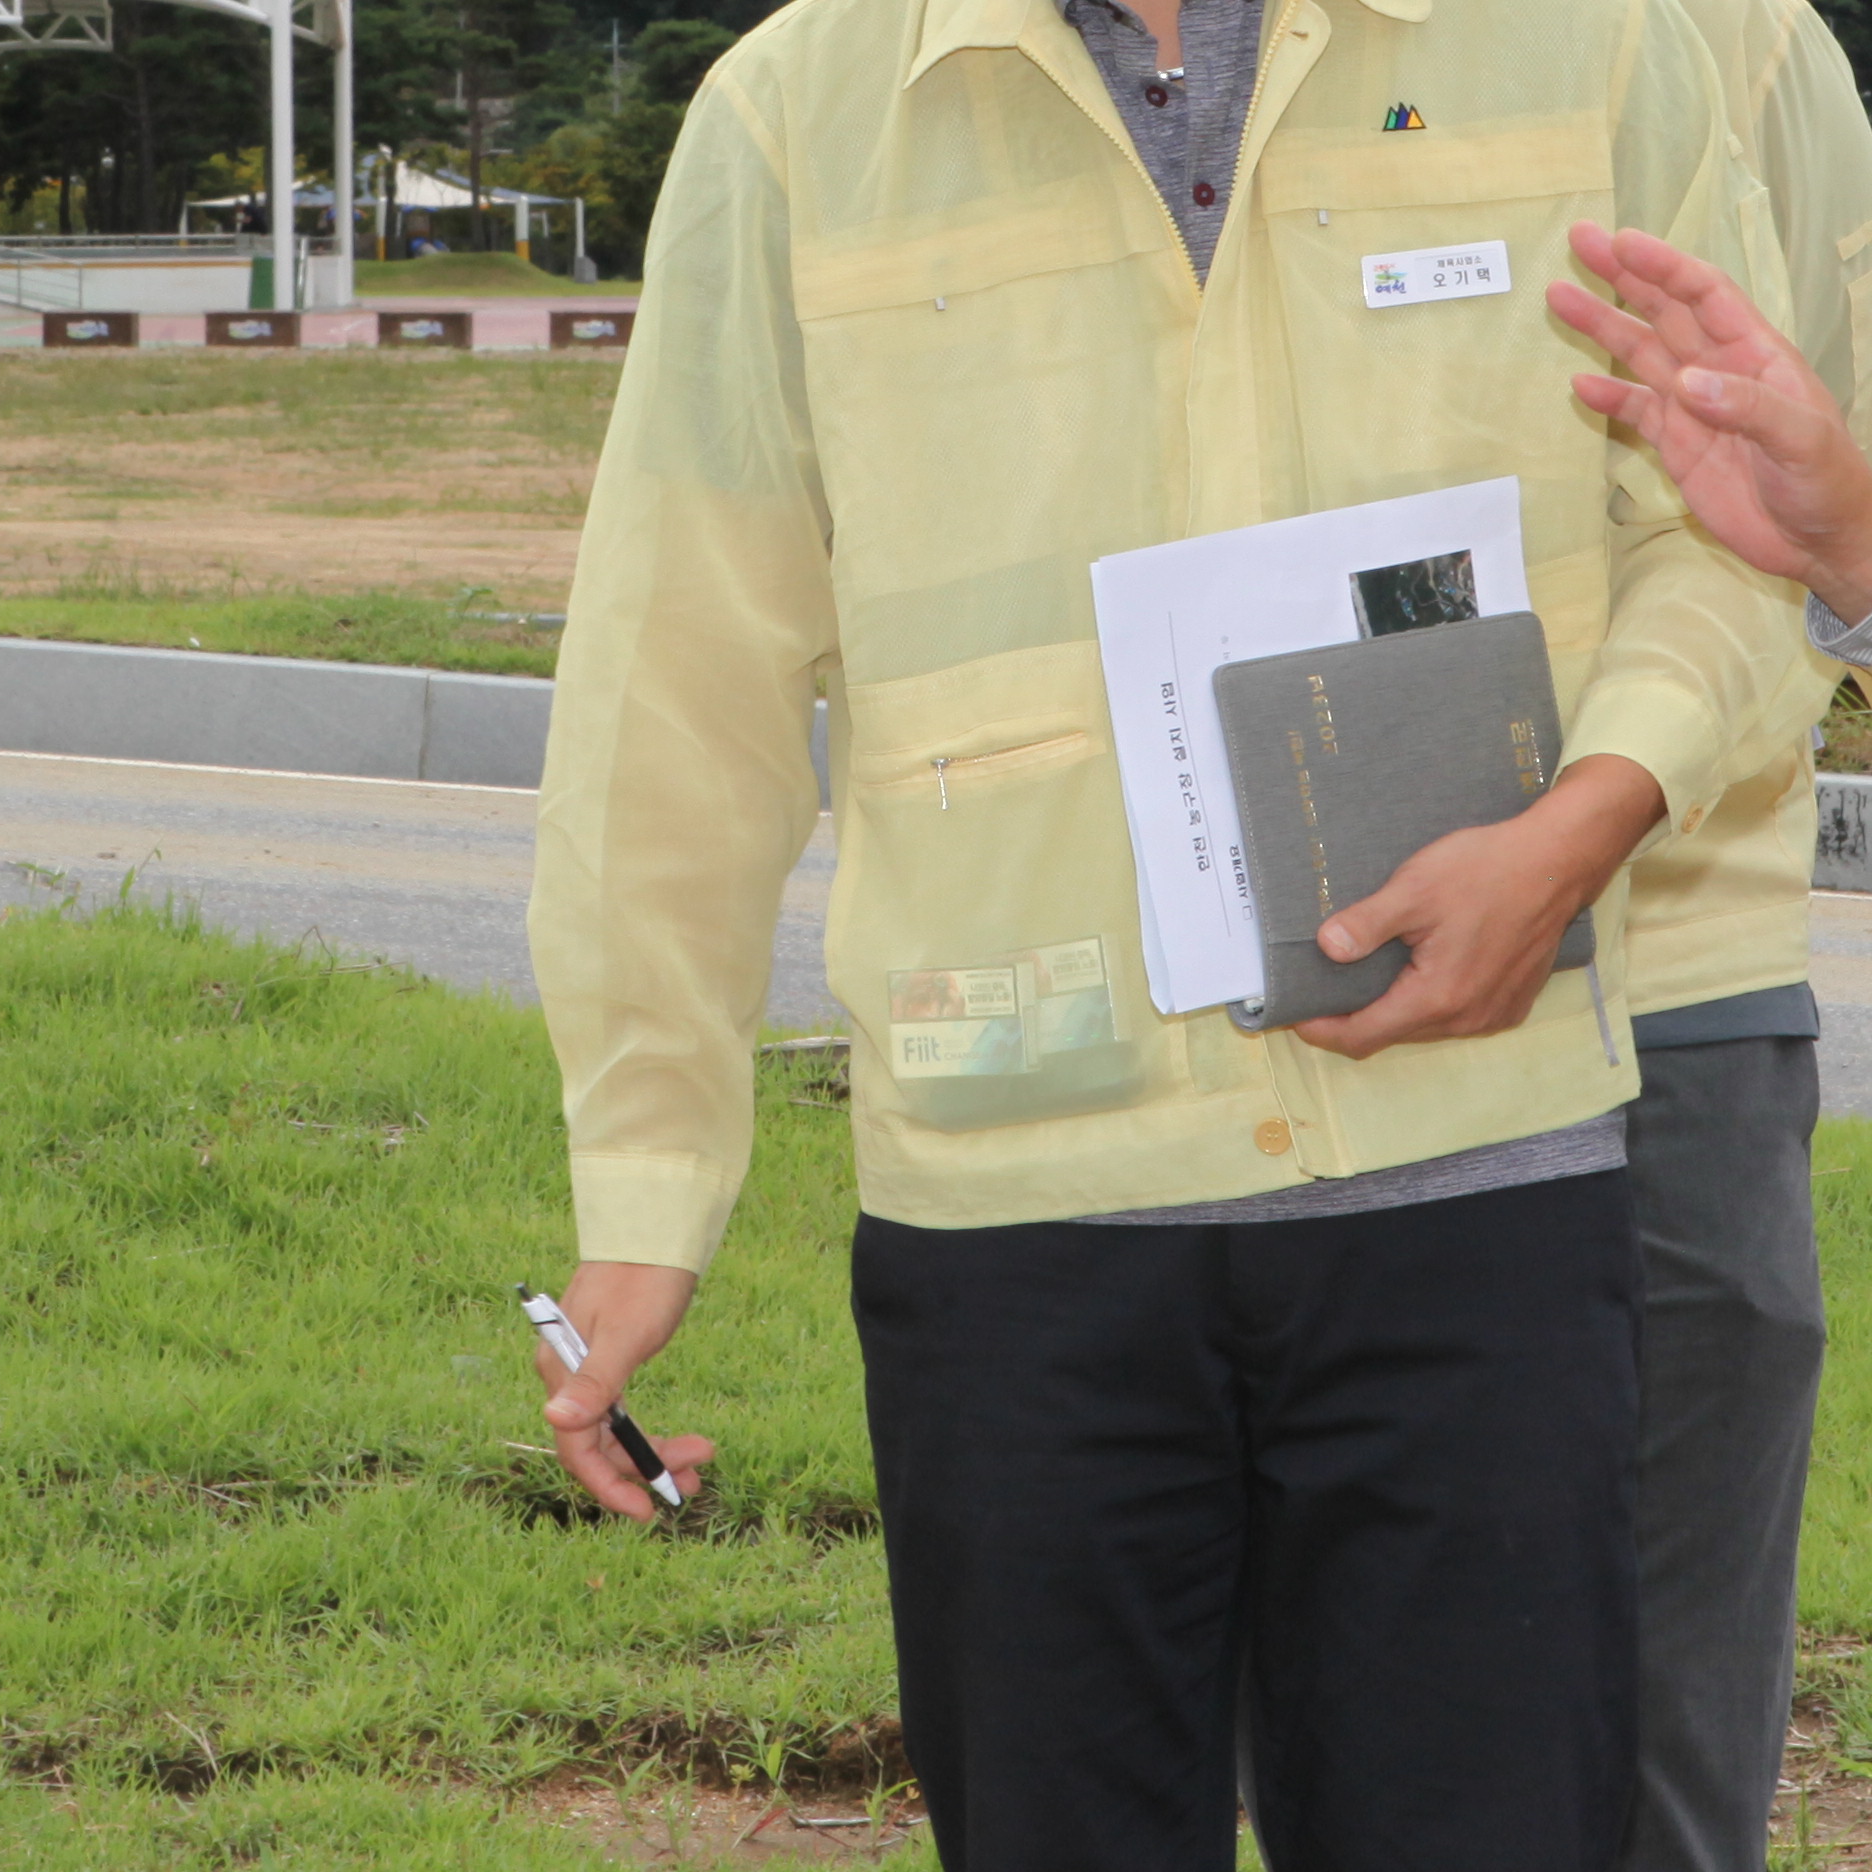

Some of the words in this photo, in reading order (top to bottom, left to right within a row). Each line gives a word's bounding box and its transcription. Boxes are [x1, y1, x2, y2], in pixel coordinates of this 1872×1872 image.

[1433, 268, 1491, 288] 오기택
[1160, 682, 1178, 716] 사업
[1169, 728, 1188, 762] 설치
[1191, 836, 1211, 872] 한천
[903, 1036, 941, 1063] Fiit
